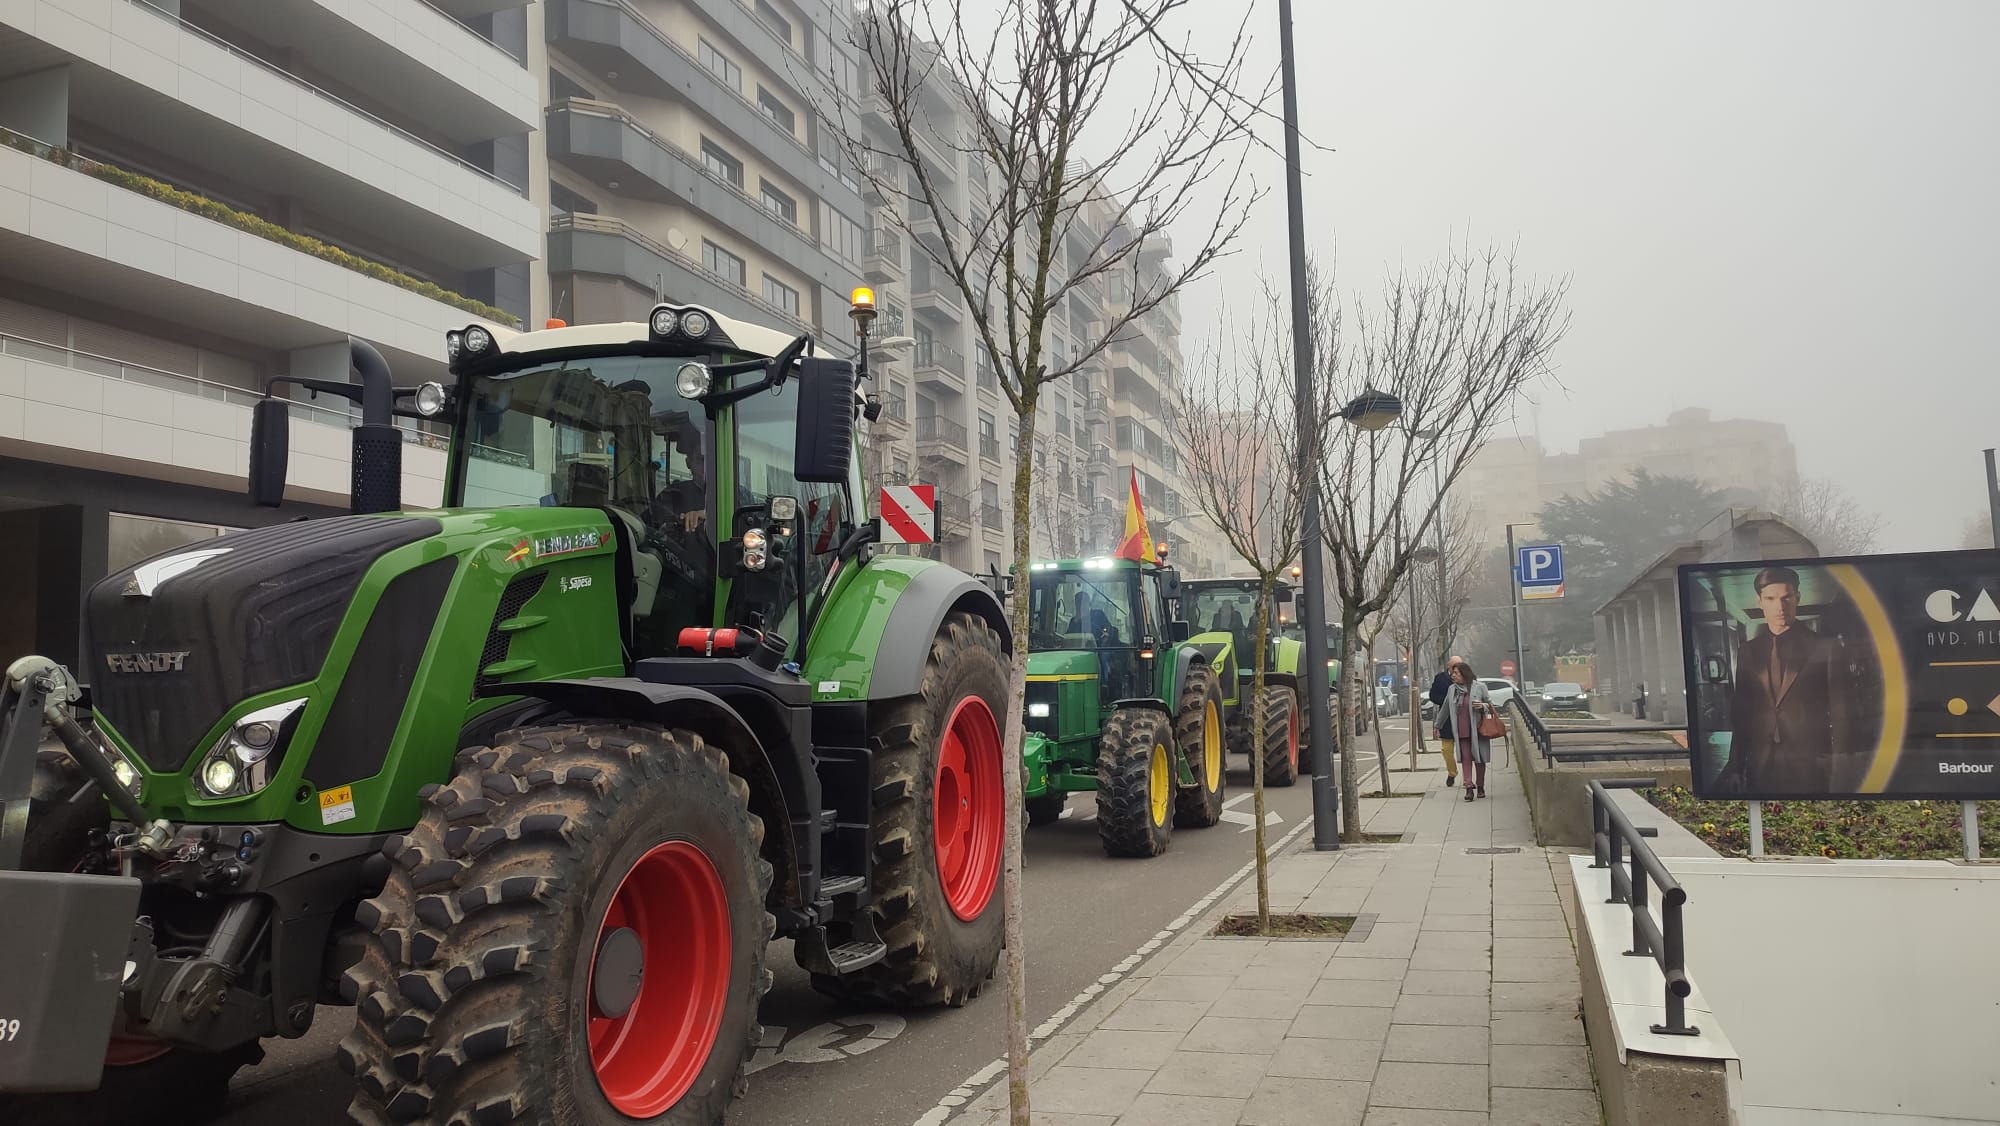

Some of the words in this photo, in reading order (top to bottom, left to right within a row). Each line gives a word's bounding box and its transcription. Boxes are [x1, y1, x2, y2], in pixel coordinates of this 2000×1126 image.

[1529, 550, 1553, 580] P
[1927, 631, 1967, 646] AVD.
[1977, 630, 2000, 645] AL
[104, 651, 191, 673] FENDT
[1938, 762, 1995, 774] Barbour
